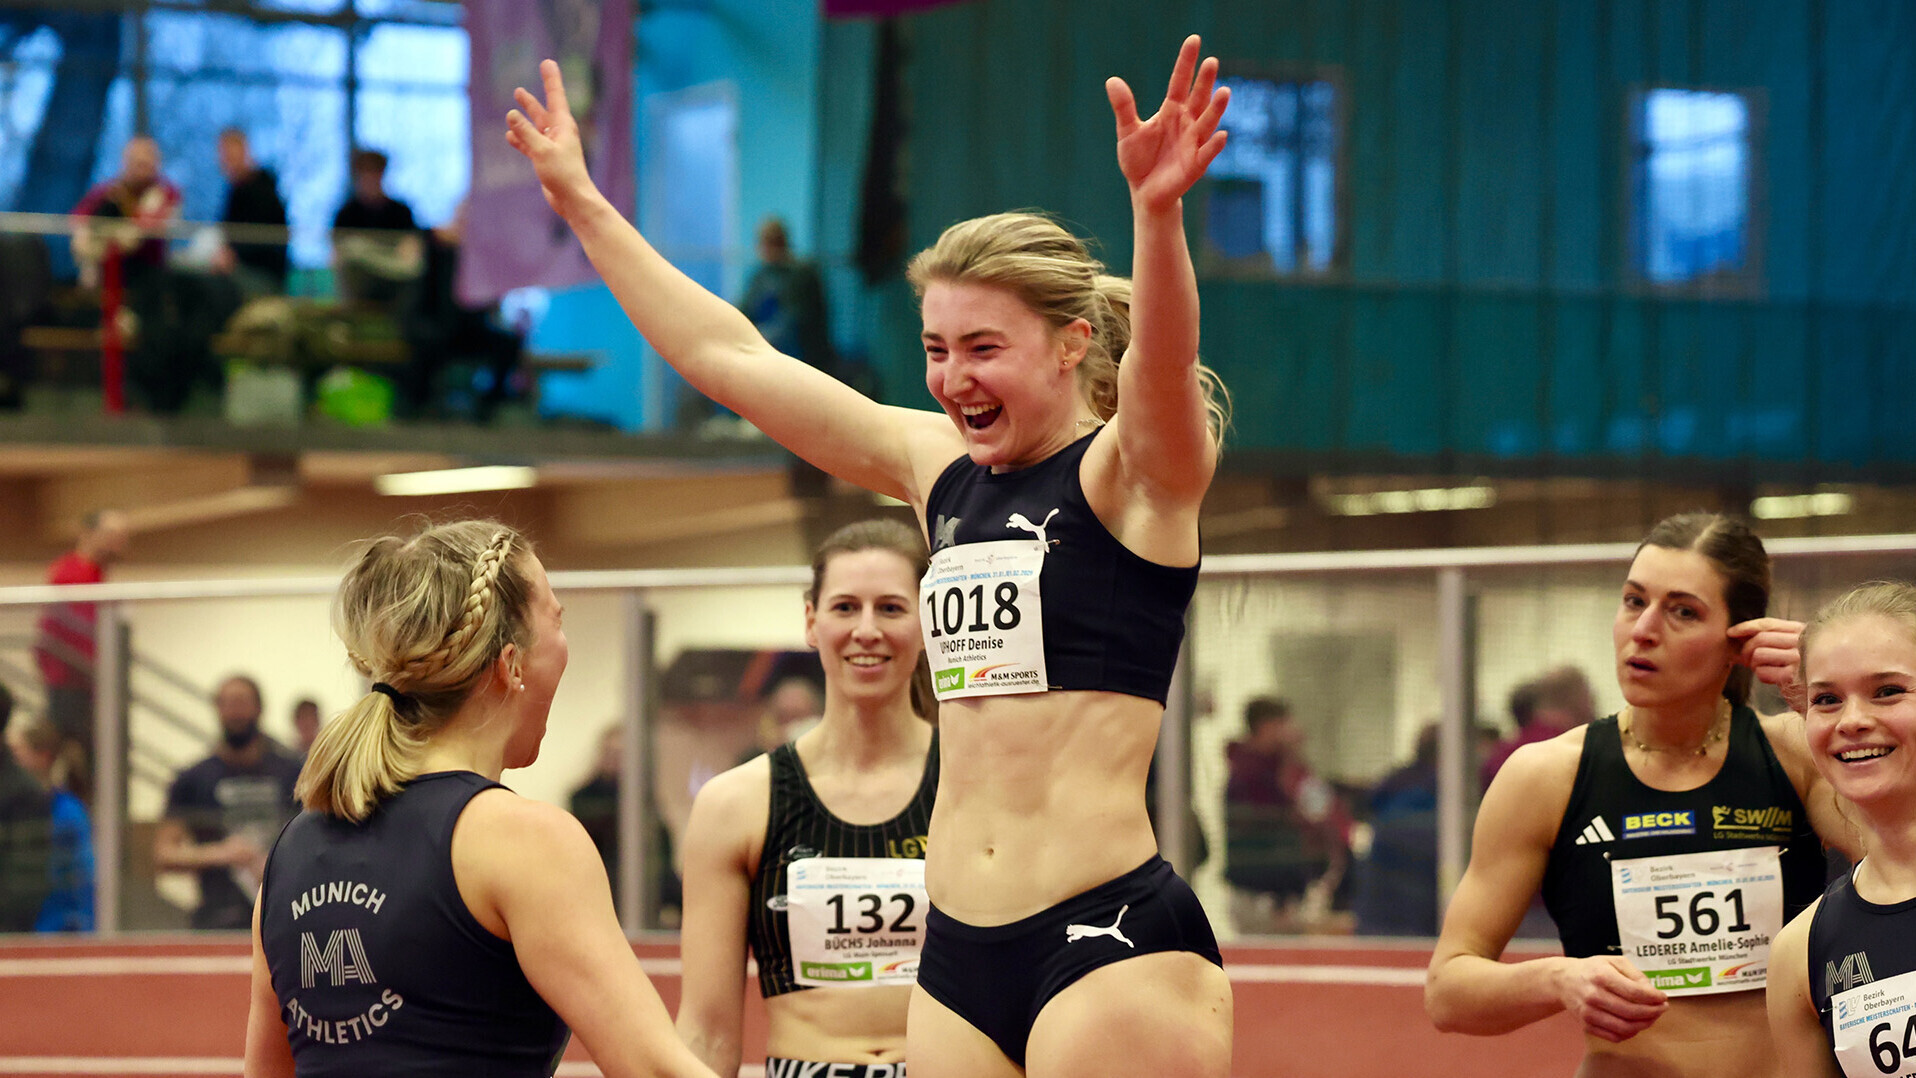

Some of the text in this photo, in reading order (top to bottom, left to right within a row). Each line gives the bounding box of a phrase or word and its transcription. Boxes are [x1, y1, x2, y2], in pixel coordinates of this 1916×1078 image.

[927, 582, 1021, 638] 1018
[968, 636, 1004, 651] Denise
[963, 654, 987, 663] Athletics
[991, 670, 1038, 681] M&M SPORTS
[1625, 812, 1692, 830] BECK
[291, 881, 386, 920] MUNICH
[827, 893, 917, 935] 132
[1655, 888, 1751, 940] 561
[825, 936, 917, 950] BÜCHS Johanna
[1636, 934, 1770, 957] LEDERER Amelie-Sophie
[301, 928, 377, 989] MA
[807, 967, 848, 979] erima
[1650, 974, 1685, 988] rima
[1863, 989, 1886, 1002] Bezirk
[1864, 995, 1905, 1011] Oberbayern
[286, 988, 404, 1045] ATHLETICS
[1839, 1016, 1865, 1031] BAYERISCHE
[1865, 1004, 1911, 1022] MEISTERSCHAFTEN
[765, 1057, 856, 1078] NIKE
